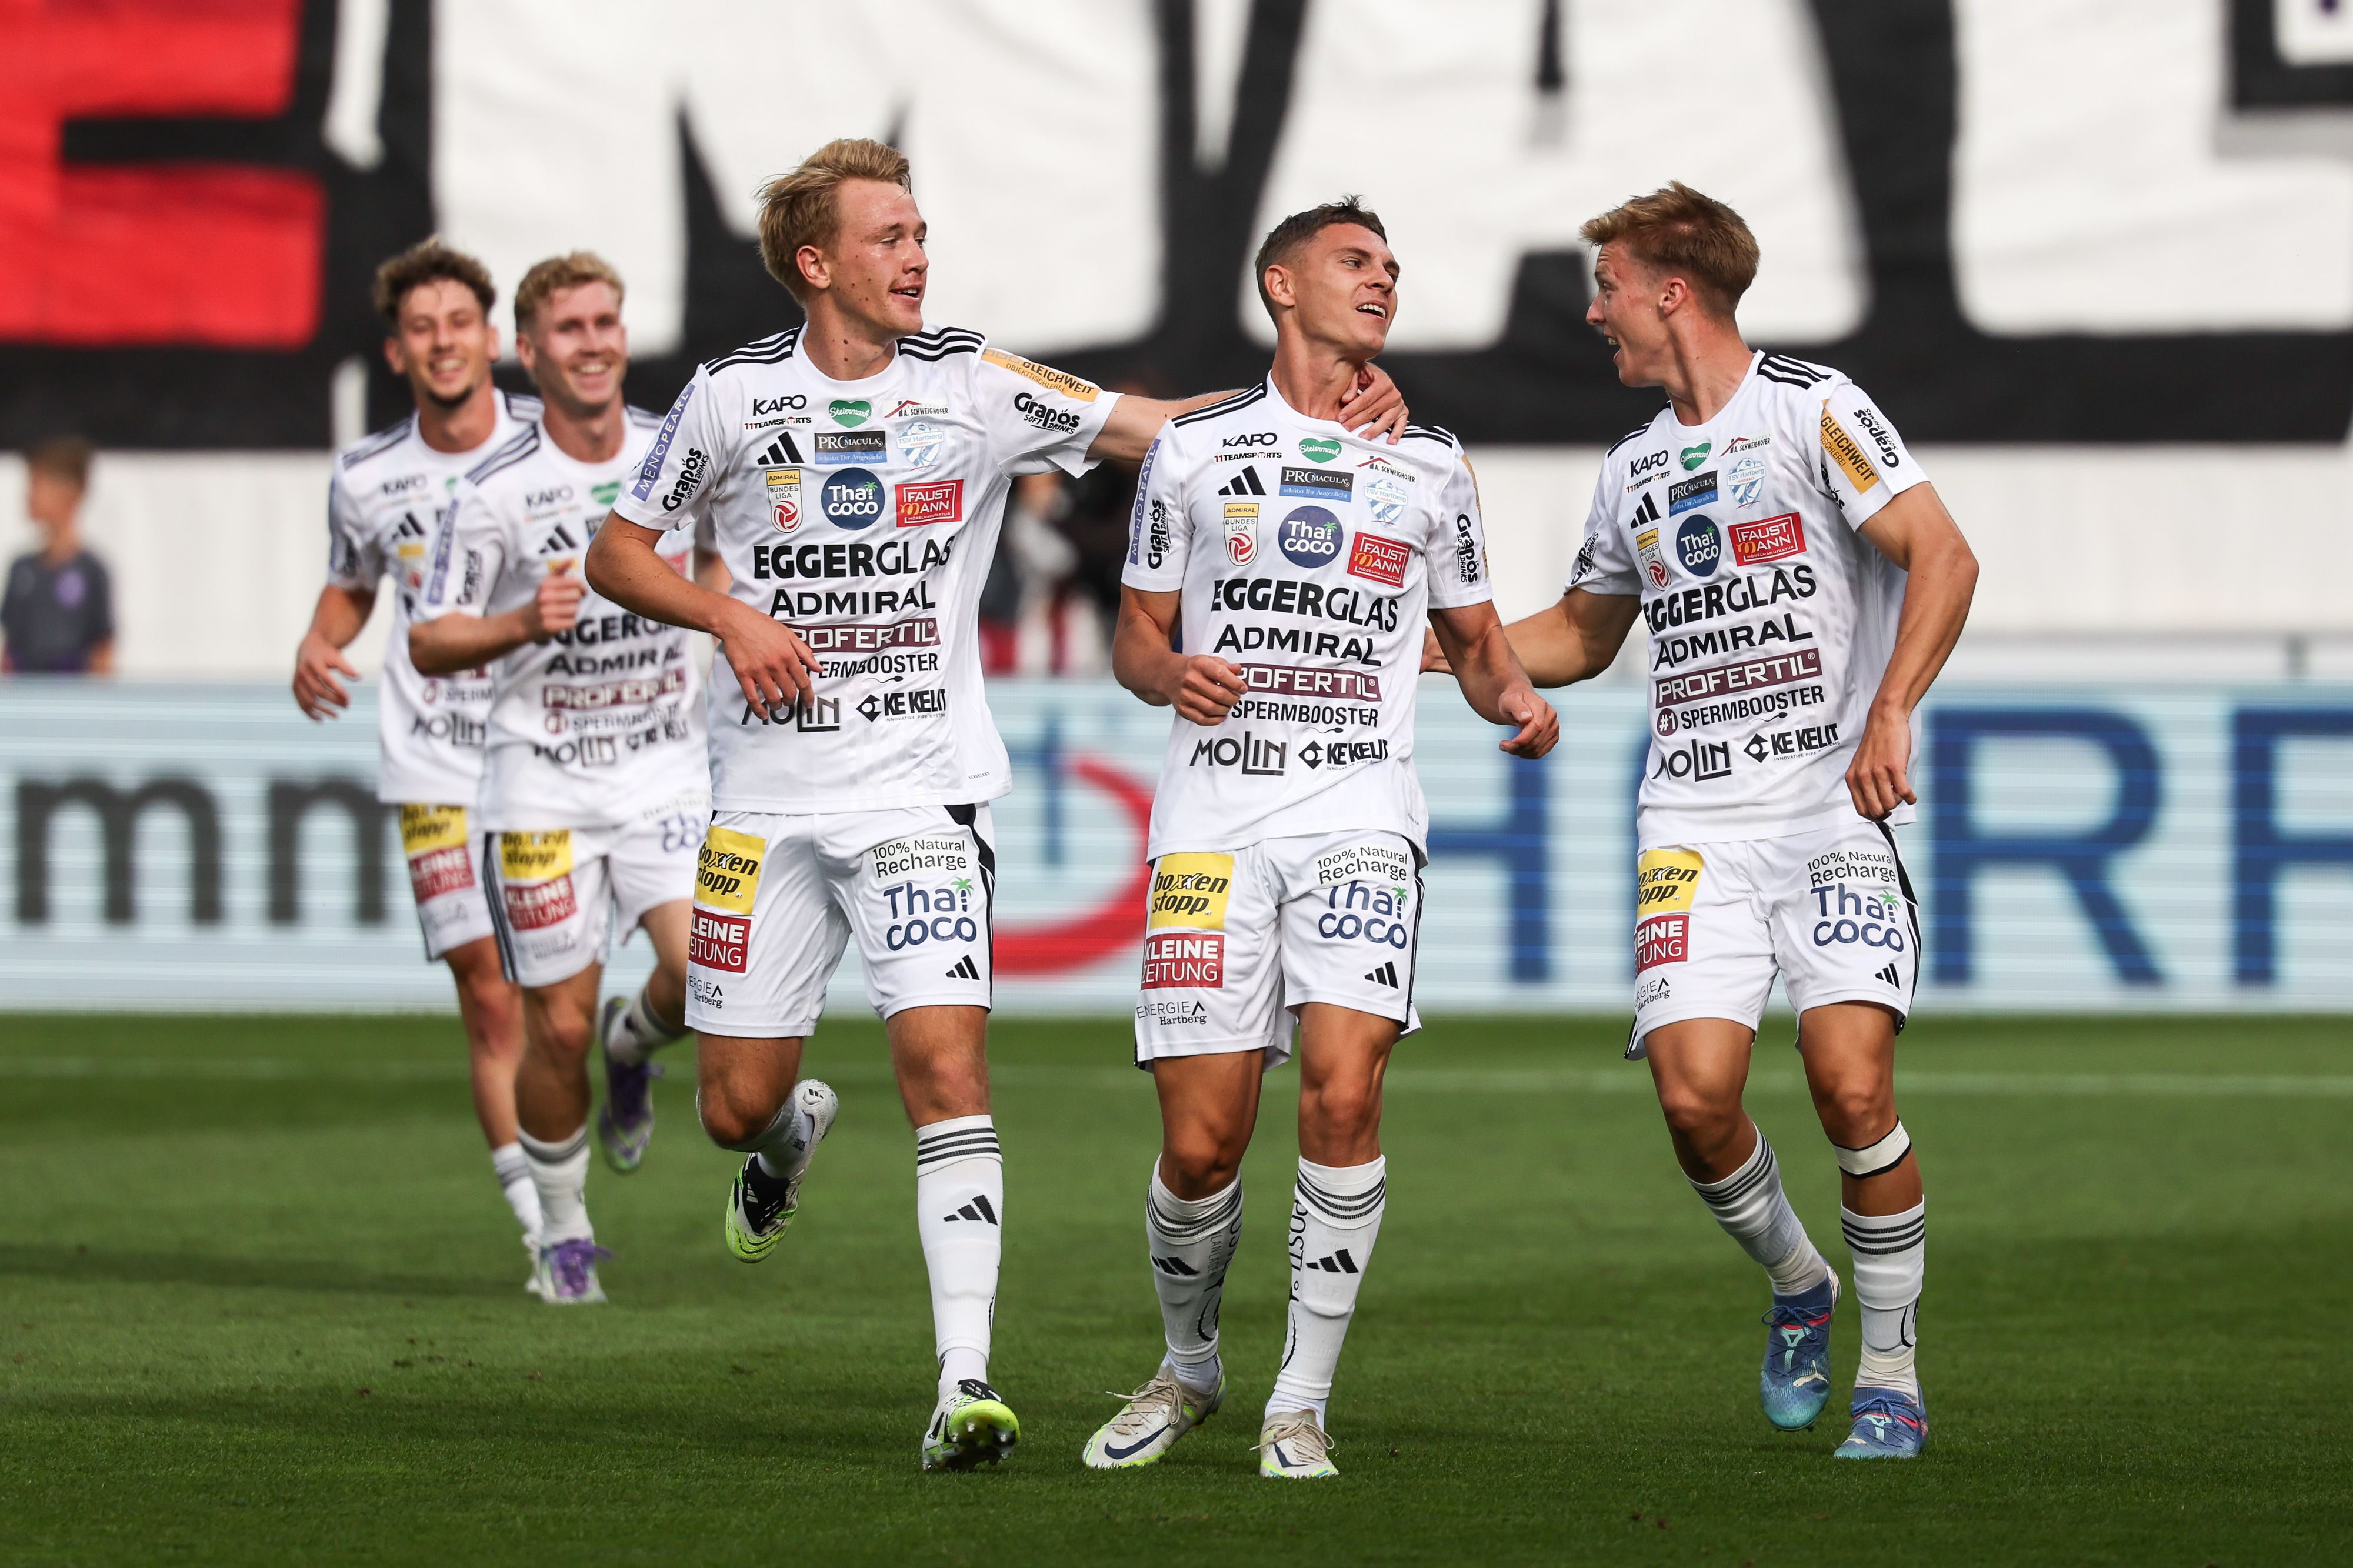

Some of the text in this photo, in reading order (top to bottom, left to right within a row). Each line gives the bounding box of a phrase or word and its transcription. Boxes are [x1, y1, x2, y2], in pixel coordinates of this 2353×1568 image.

[1022, 362, 1095, 394] GLEICHWEIT
[753, 394, 807, 416] KAPO
[829, 406, 871, 419] Steiermark
[911, 407, 949, 416] SCHWEIGHOFER
[1014, 392, 1081, 428] Grapos
[1024, 415, 1075, 435] SOFT DRINKS
[1865, 408, 1898, 451] SOFT DRINKS
[639, 393, 689, 492] MENOPEARL
[913, 433, 942, 442] Hartberg
[1223, 432, 1278, 448] KAPO
[1739, 438, 1771, 452] SCHWEIGHOFER
[1821, 416, 1875, 481] GLEICHWEIT
[1854, 409, 1899, 468] Grapos
[1299, 443, 1341, 456] Steiermark
[1381, 466, 1415, 483] SCHWEIGHOFER
[1630, 449, 1669, 478] KAPO
[1740, 468, 1764, 478] Hartberg
[662, 448, 702, 511] Grapos
[685, 455, 709, 500] SOFT DRINKS
[828, 483, 875, 501] Thai
[908, 489, 952, 502] FAUST
[1131, 448, 1156, 556] MENOPEARL
[1366, 488, 1407, 503] TSV Hartberg
[1148, 499, 1166, 569] Grapos
[1287, 521, 1332, 541] Thai
[1638, 533, 1657, 546] ADMIRAL
[1681, 532, 1714, 552] Thai
[1741, 522, 1789, 541] FAUST
[1161, 536, 1169, 553] SOFT
[1364, 542, 1405, 562] FAUST
[1457, 513, 1478, 583] Grapos
[1641, 544, 1658, 557] BUNDES
[1645, 552, 1656, 561] LIGA
[770, 581, 936, 618] ADMIRAL
[1211, 578, 1398, 632] EGGERGLAS
[1213, 623, 1381, 667] ADMIRAL
[1653, 612, 1813, 672] ADMIRAL
[884, 692, 906, 716] KE
[1231, 700, 1378, 728] SPERMBOOSTER
[1681, 685, 1824, 730] SPERMBOOSTER
[1771, 731, 1794, 756] KE
[1795, 723, 1839, 752] KELIT
[1189, 731, 1288, 776] MOLIN
[1327, 742, 1348, 765] KE
[1774, 753, 1804, 762] INNOVATIVE
[873, 839, 965, 859] 100% Natural
[1317, 846, 1408, 869] 100% Natural
[876, 853, 967, 878] Recharge
[1319, 858, 1407, 885] Recharge
[1807, 851, 1892, 872] 100% Natura
[1154, 871, 1228, 893] boxxen
[1638, 866, 1698, 888] oxxen
[1810, 863, 1896, 887] Recharge
[884, 880, 969, 919] Thai
[1811, 882, 1897, 923] Thai
[689, 935, 742, 967] EITUNG
[1637, 989, 1671, 1013] Hartberg
[1159, 1015, 1207, 1026] Hartberg
